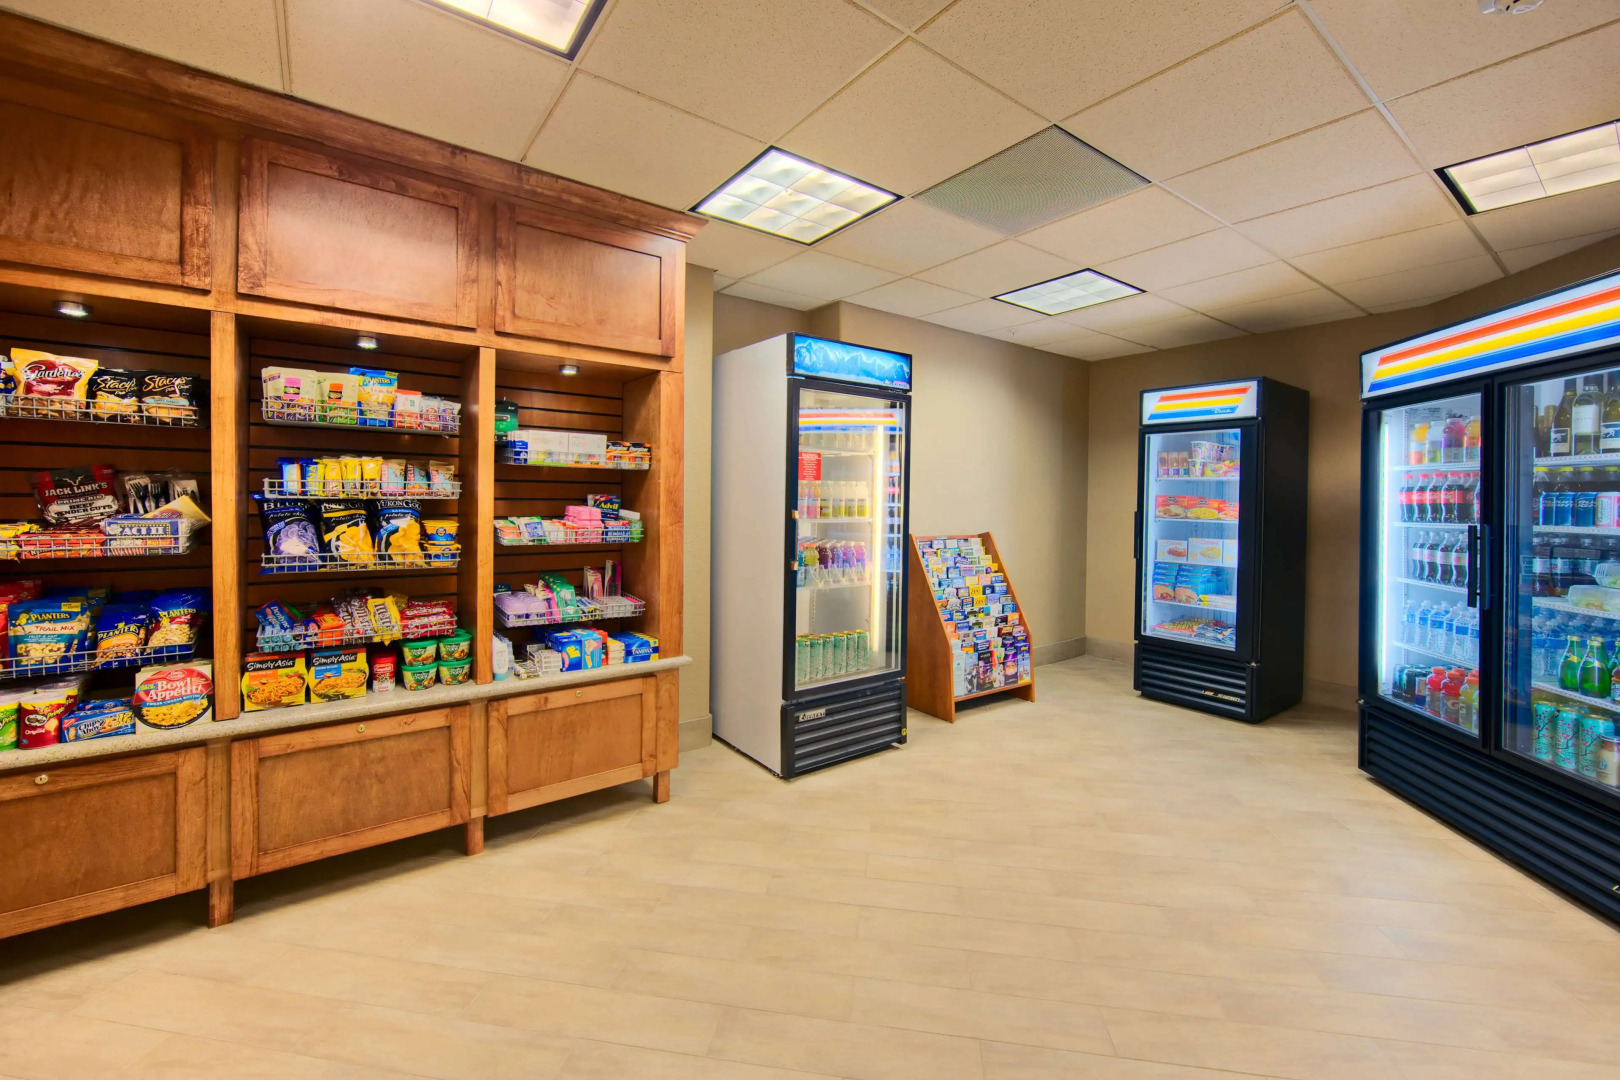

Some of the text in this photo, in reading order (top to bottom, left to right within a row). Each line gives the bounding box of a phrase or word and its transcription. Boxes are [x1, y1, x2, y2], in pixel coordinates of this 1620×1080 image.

[44, 482, 109, 497] JACK LINK'S
[69, 502, 95, 510] BEEF
[89, 504, 113, 512] CUTS
[599, 502, 619, 510] Advil
[122, 527, 148, 535] ACT
[30, 612, 70, 621] PLANTERS
[246, 659, 294, 671] Simply Asia
[312, 654, 357, 666] Simply Asia
[156, 677, 191, 692] Bowl
[116, 711, 133, 722] 12
[79, 719, 101, 731] Chips
